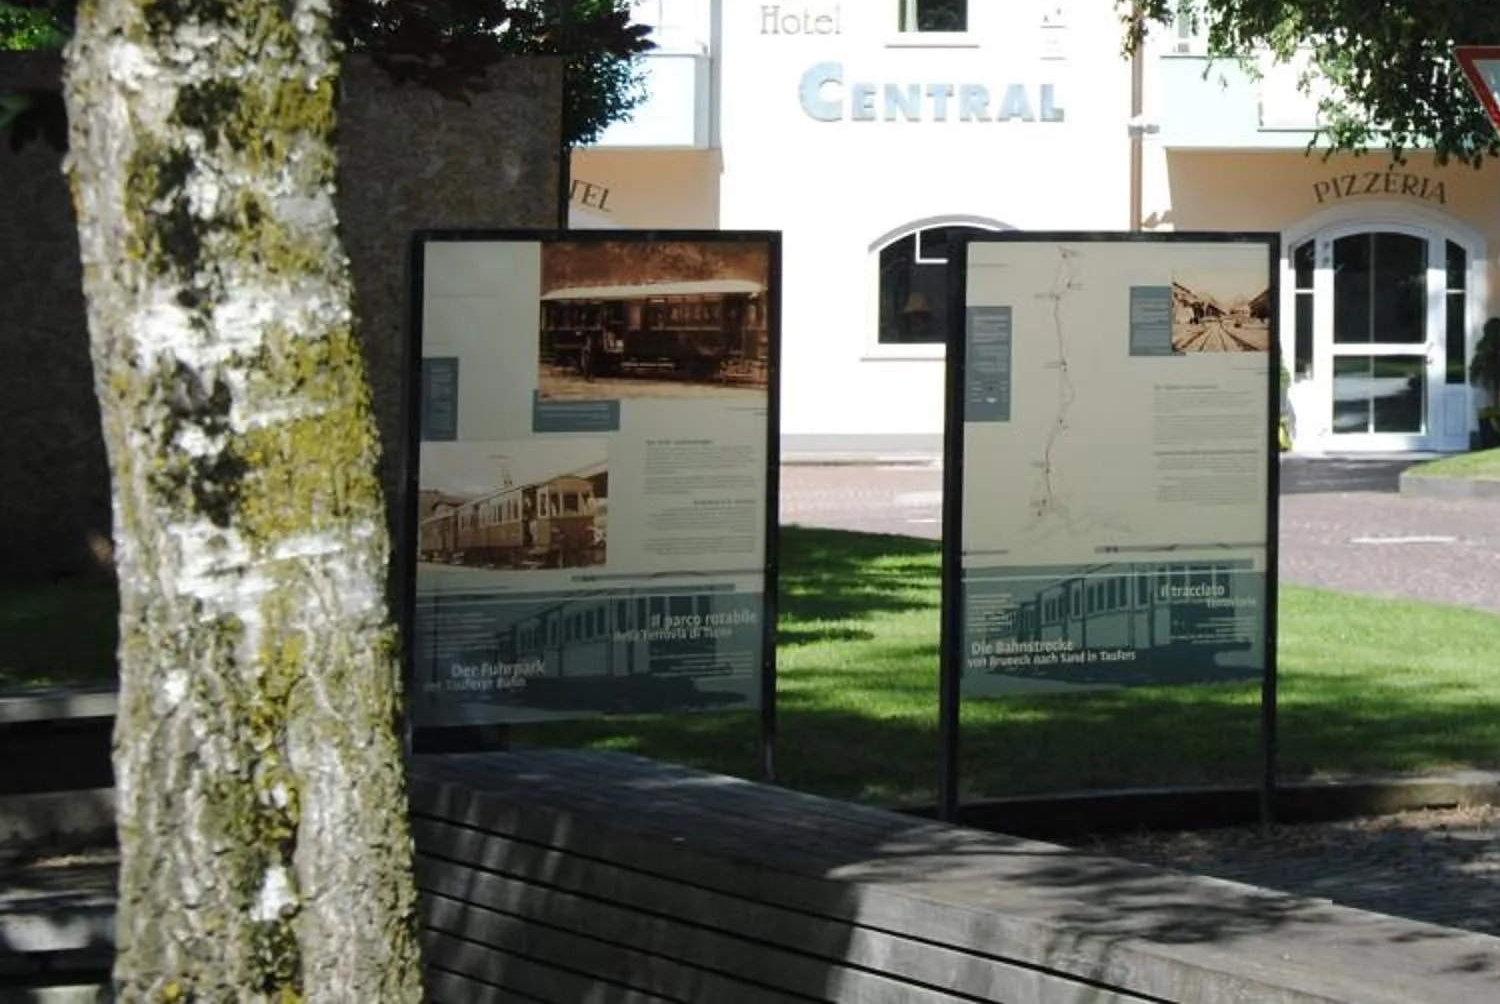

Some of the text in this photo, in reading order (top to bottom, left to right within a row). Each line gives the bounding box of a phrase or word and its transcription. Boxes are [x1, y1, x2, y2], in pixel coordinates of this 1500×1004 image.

[759, 4, 841, 35] Hotel
[1171, 582, 1225, 597] tracciato
[665, 615, 701, 630] parco
[706, 609, 758, 625] rotabile
[971, 639, 1073, 654] Die Bahnstrecke
[1101, 648, 1137, 661] Taufers
[451, 664, 479, 677] Der
